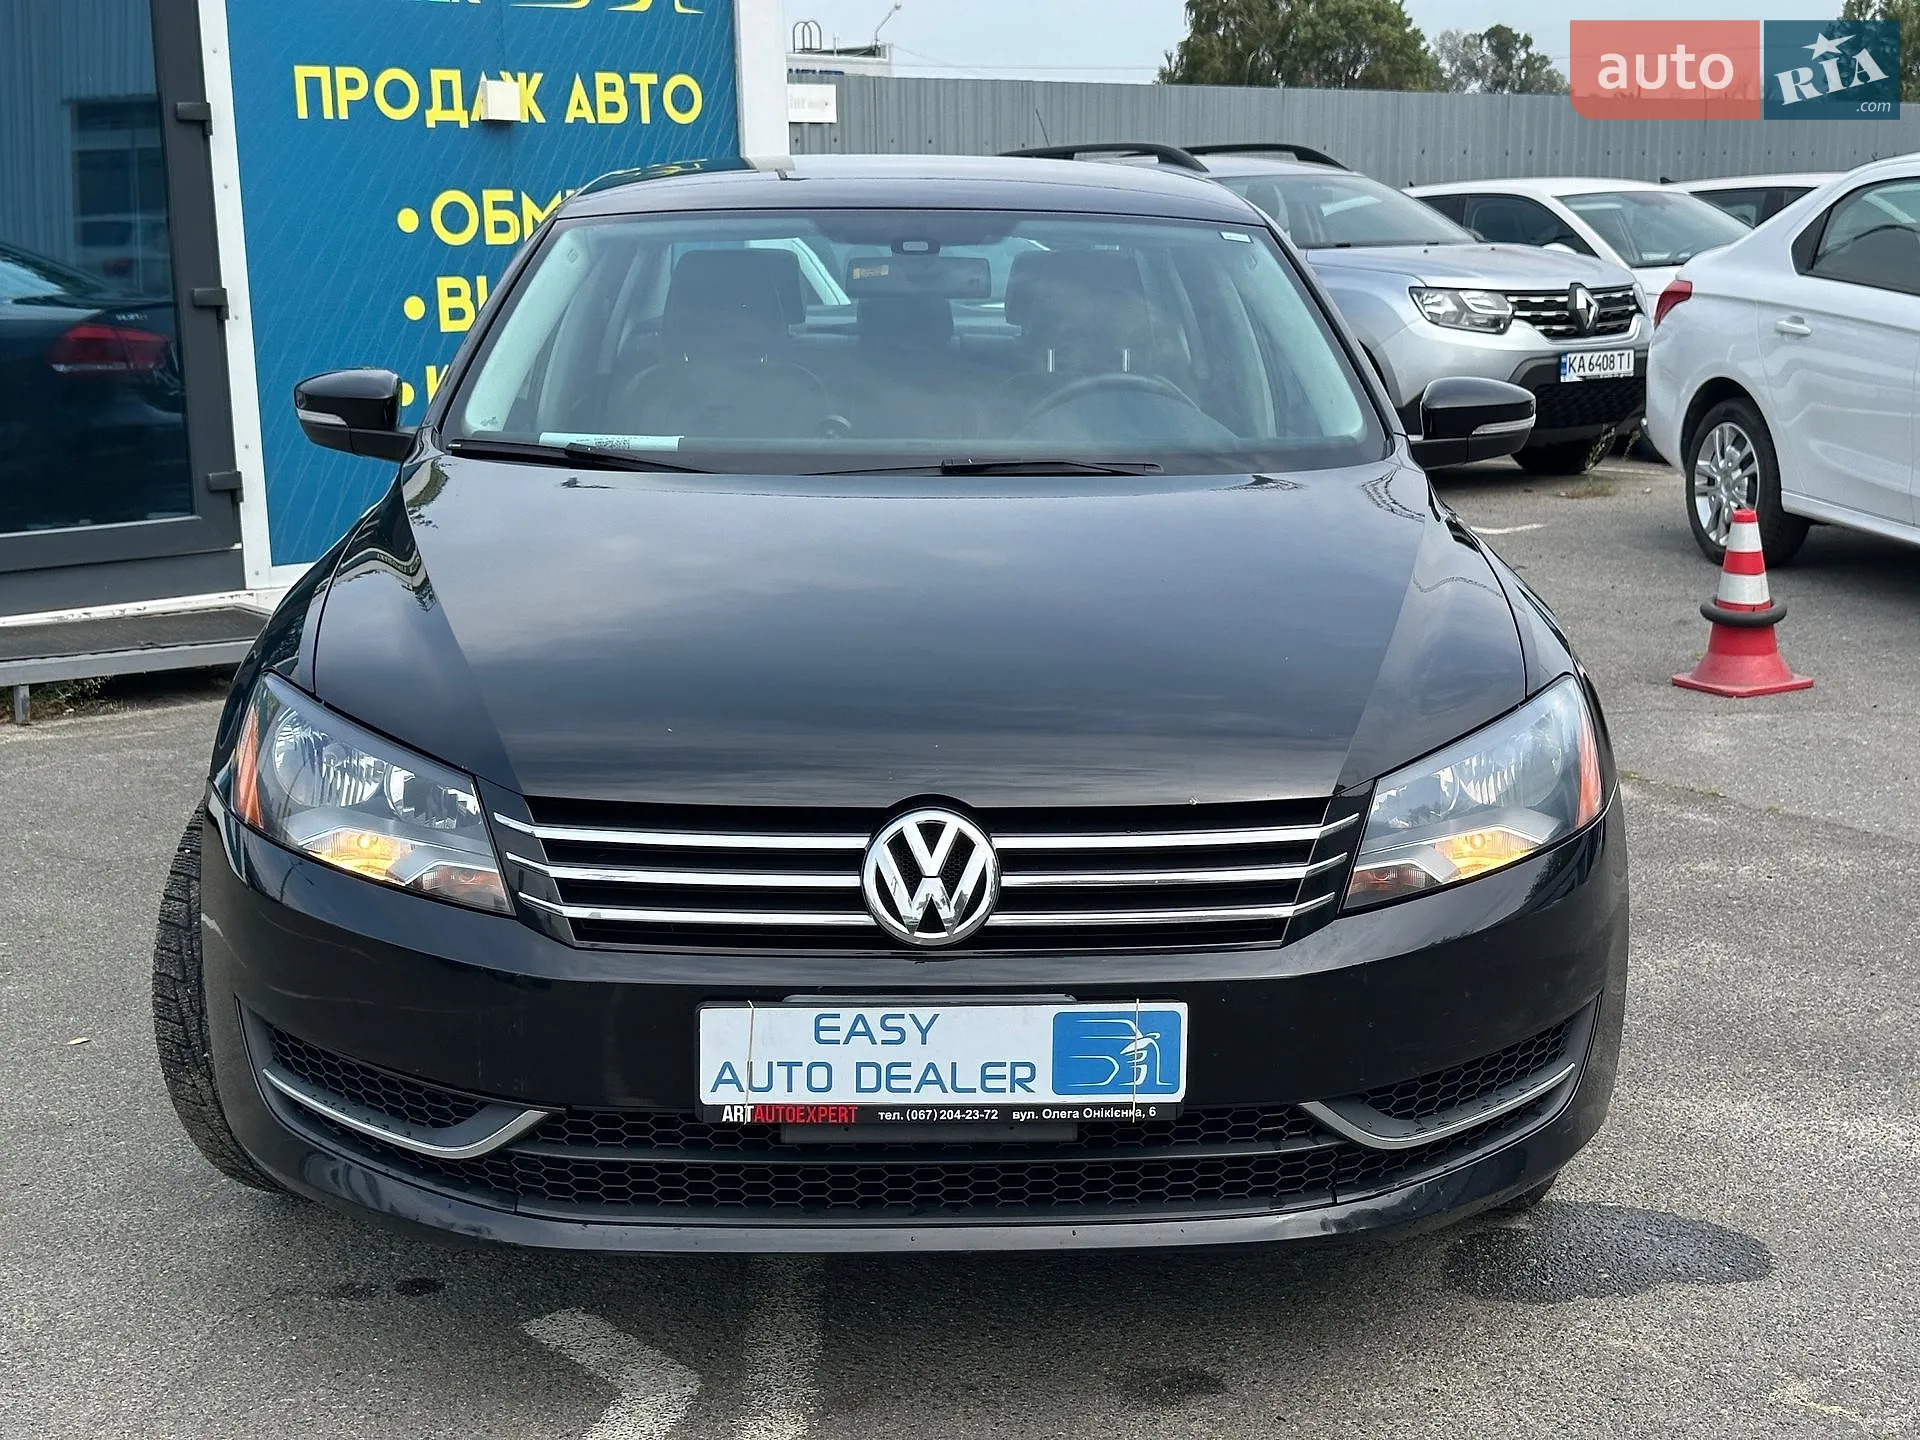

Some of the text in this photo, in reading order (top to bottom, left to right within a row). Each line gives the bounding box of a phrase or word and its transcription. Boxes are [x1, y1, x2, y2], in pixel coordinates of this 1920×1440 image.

[564, 71, 703, 125] АВТО
[1588, 354, 1615, 371] 6408
[813, 1013, 940, 1045] EASY
[710, 1061, 1037, 1094] AUTO DEALER
[878, 1111, 904, 1120] тел.
[1012, 1110, 1039, 1121] вул.
[1042, 1108, 1080, 1119] Олега
[1148, 1106, 1157, 1117] 6
